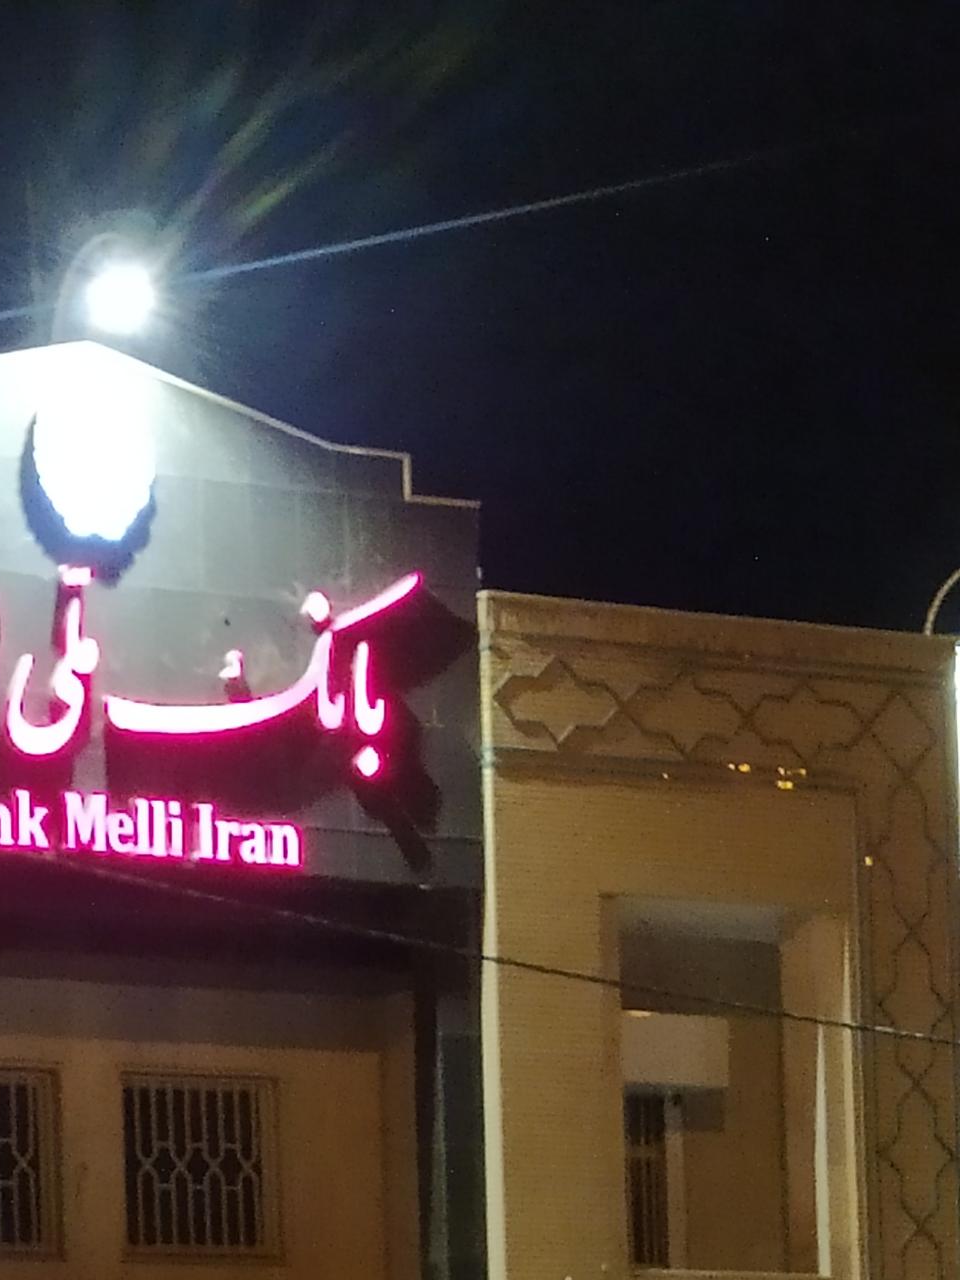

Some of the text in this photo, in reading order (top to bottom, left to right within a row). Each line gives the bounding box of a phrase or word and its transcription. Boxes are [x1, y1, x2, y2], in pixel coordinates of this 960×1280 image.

[102, 572, 421, 778] بانک
[64, 791, 185, 860] Melli
[192, 803, 301, 866] Iran
